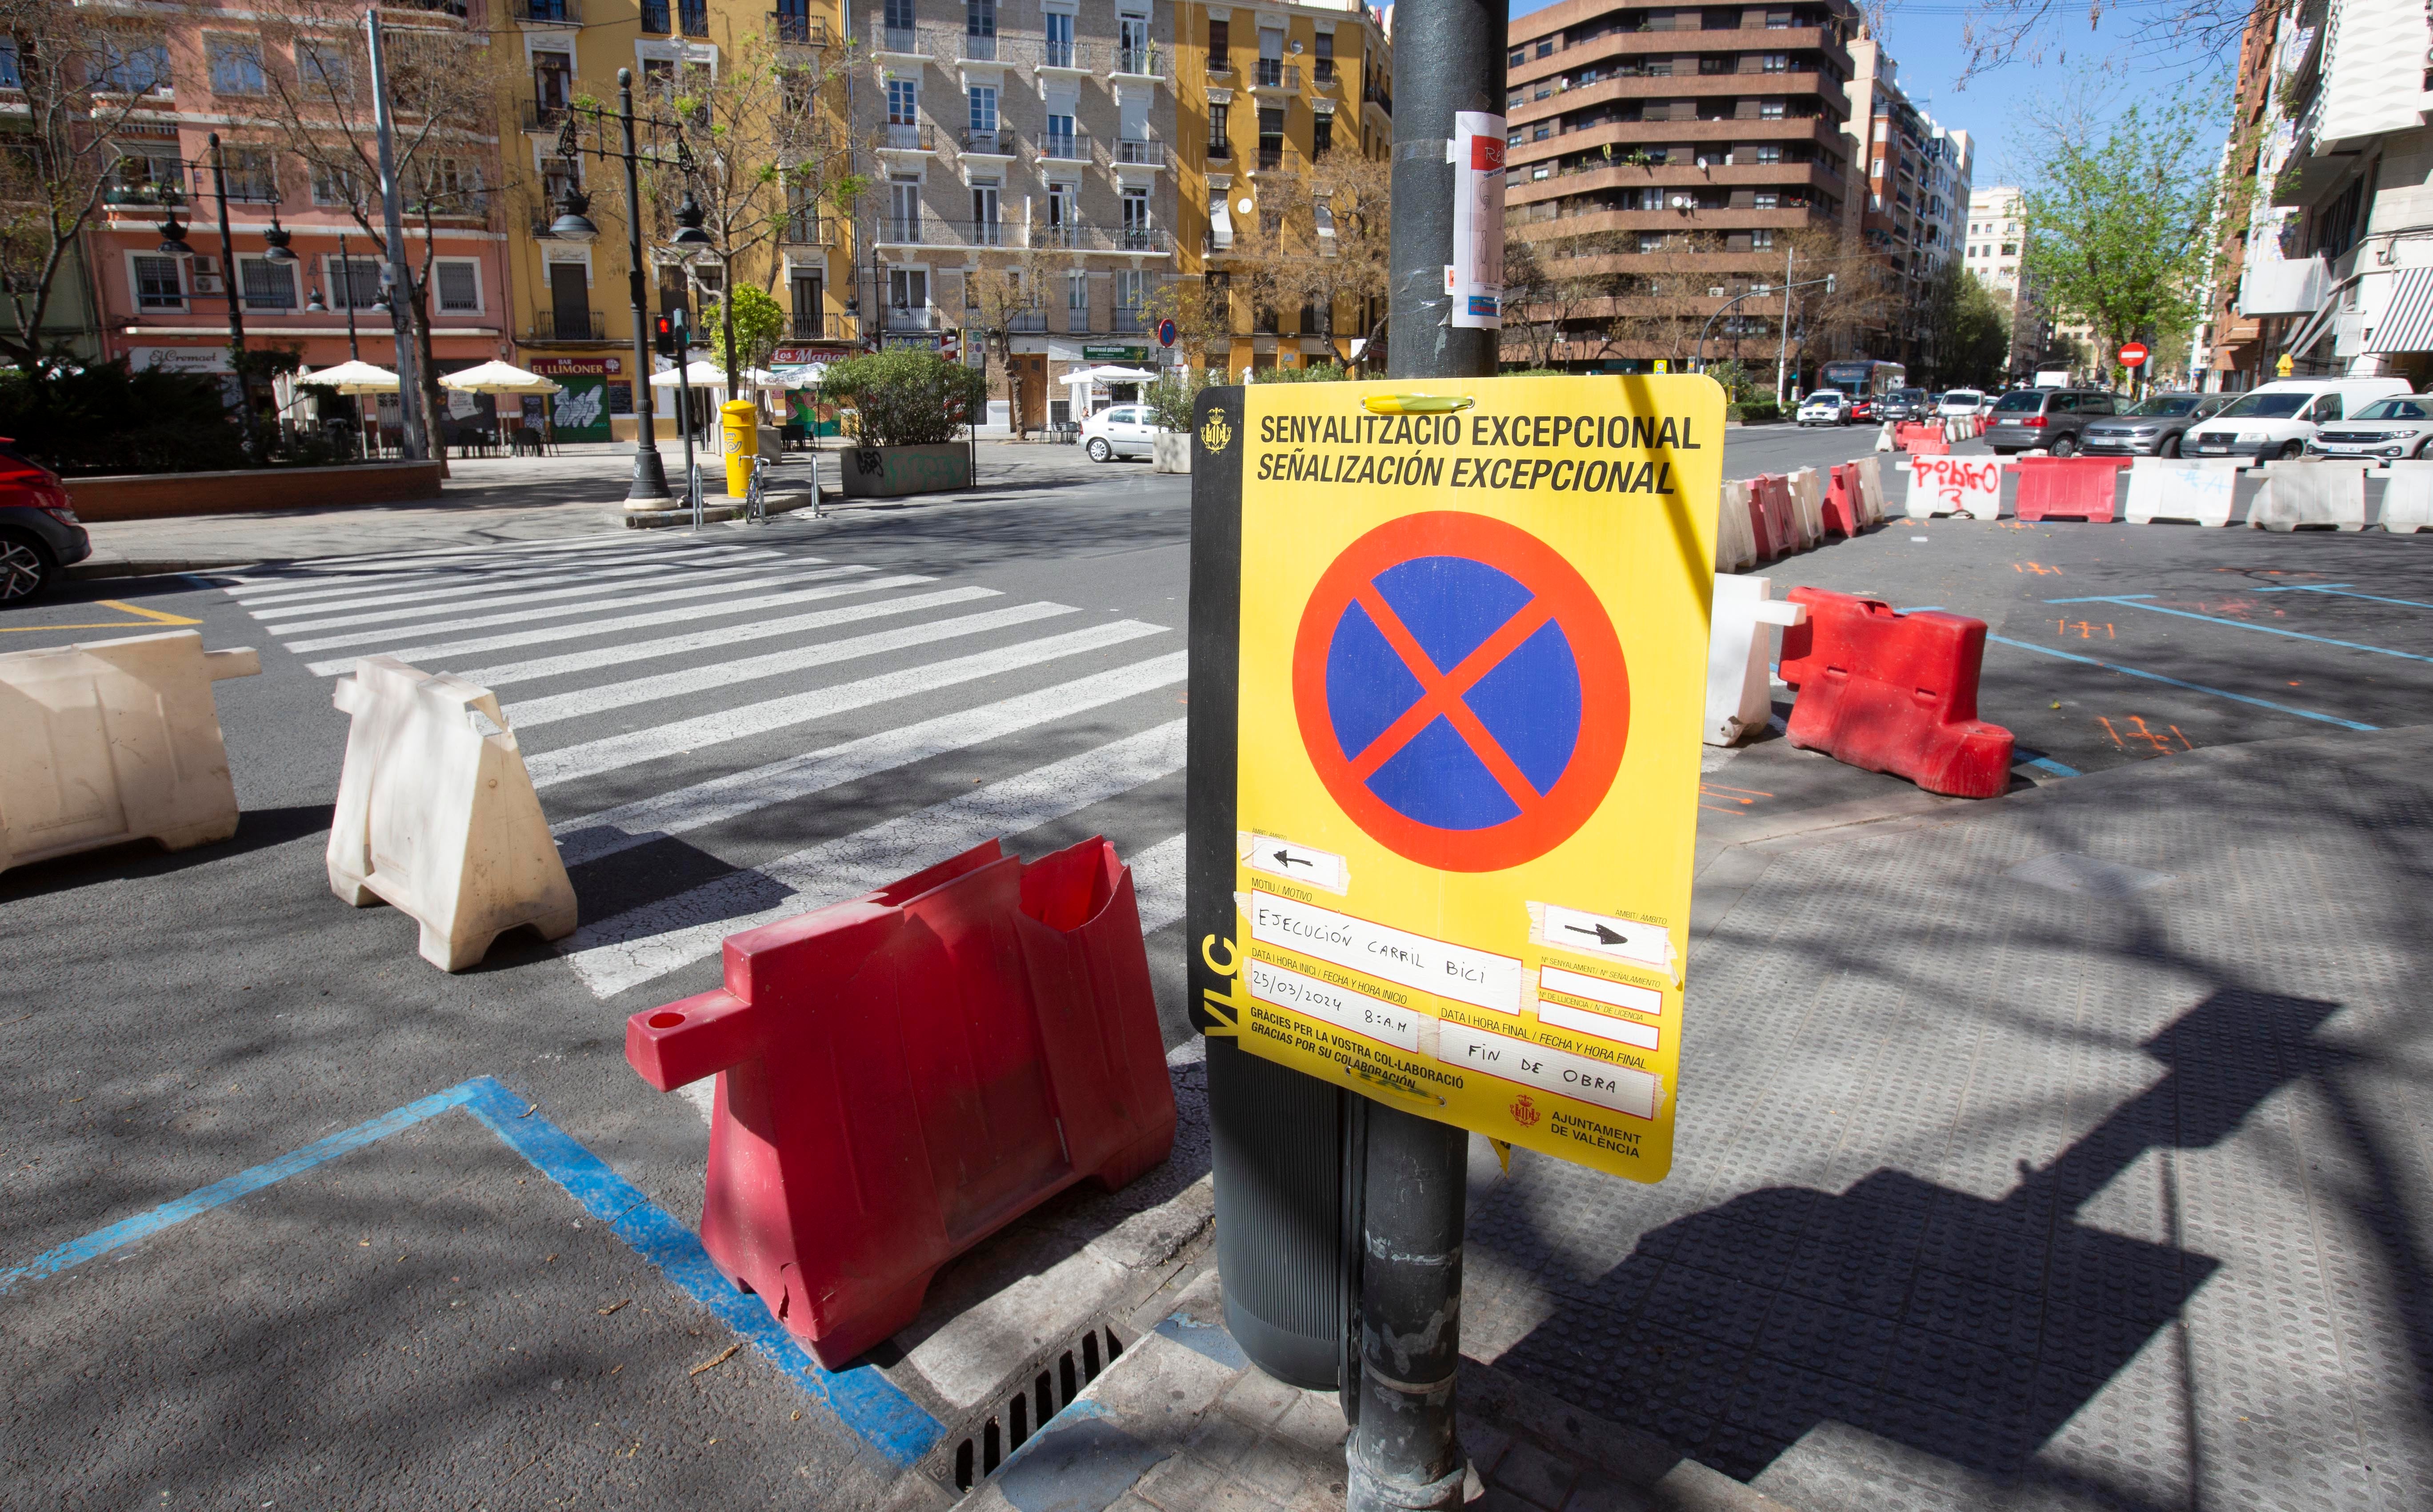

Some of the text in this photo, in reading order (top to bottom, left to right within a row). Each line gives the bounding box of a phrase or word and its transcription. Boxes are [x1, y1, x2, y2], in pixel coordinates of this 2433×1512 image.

[149, 349, 163, 362] El
[533, 364, 604, 374] EL LLIMONER
[772, 349, 850, 362] Los Maños
[1261, 413, 1701, 449] SENYALITZACIÓ EXCEPCIONAL
[1257, 448, 1675, 495] SEÑALIZACIÓN EXCEPCIONAL
[1252, 877, 1275, 892] MOTIU
[1282, 886, 1313, 902] MOTIVO
[1202, 934, 1238, 1036] VLC
[1252, 947, 1271, 962] DATA
[1273, 954, 1275, 963] I
[1277, 956, 1297, 970] HORA
[1300, 963, 1316, 976] INICI
[1323, 970, 1349, 986] FECHA
[1352, 980, 1357, 988] Y
[1358, 981, 1380, 996] HORA
[1382, 989, 1407, 1004] INICIO
[1253, 971, 1341, 1011] 25/03/2024
[1609, 972, 1661, 988] SEÑALAMIENTO
[1614, 1009, 1643, 1021] LICENCIA
[1250, 1006, 1291, 1029] GRÀCIES
[1294, 1021, 1313, 1037] PER
[1316, 1029, 1329, 1043] LA
[1331, 1034, 1372, 1060] VOSTRA
[1441, 1008, 1466, 1023] DATA
[1468, 1015, 1470, 1024] I
[1473, 1016, 1500, 1032] HORA
[1503, 1024, 1530, 1039] FINAL
[1540, 1033, 1572, 1050] FECHA
[1576, 1042, 1584, 1052] Y
[1585, 1044, 1614, 1061] HORA
[1617, 1053, 1646, 1069] FINAL
[1251, 1021, 1416, 1089] GRACIAS POR SU COLABORACIÓN
[1521, 1058, 1544, 1074] DE
[1563, 1070, 1616, 1093] OBRA
[1551, 1124, 1640, 1158] DE VALÈNCIA
[1552, 1111, 1642, 1145] AJUNTAMENT
